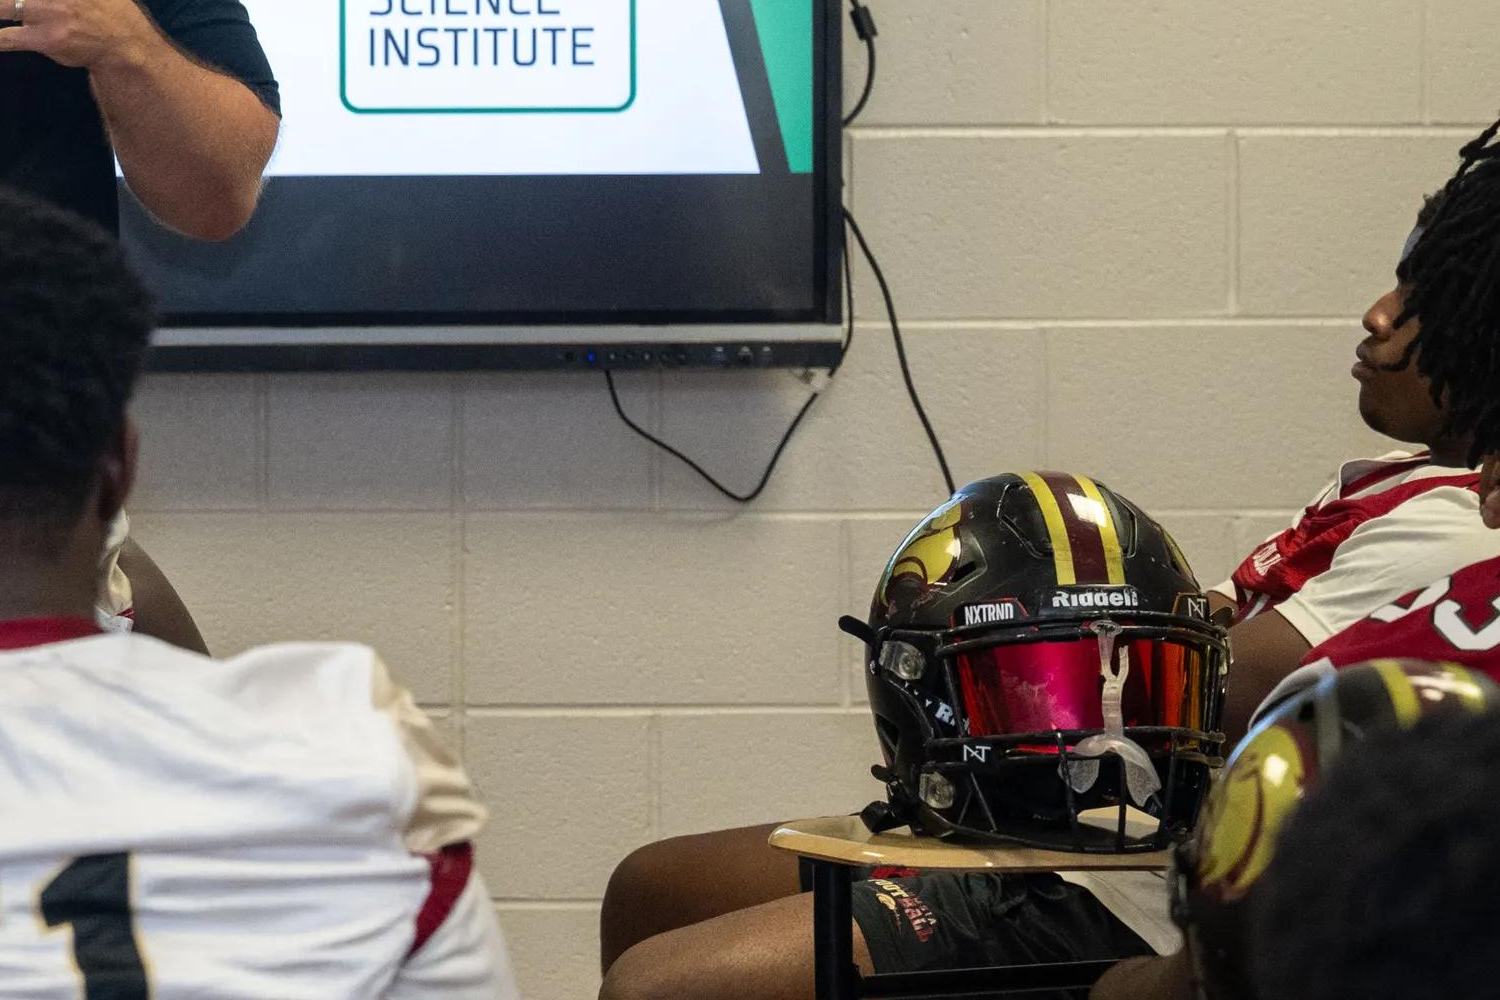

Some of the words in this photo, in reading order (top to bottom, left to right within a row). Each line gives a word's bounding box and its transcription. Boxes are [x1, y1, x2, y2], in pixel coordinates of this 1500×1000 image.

[369, 27, 595, 67] INSTITUTE
[1052, 590, 1138, 607] Riddell
[964, 603, 1014, 626] NXTRND
